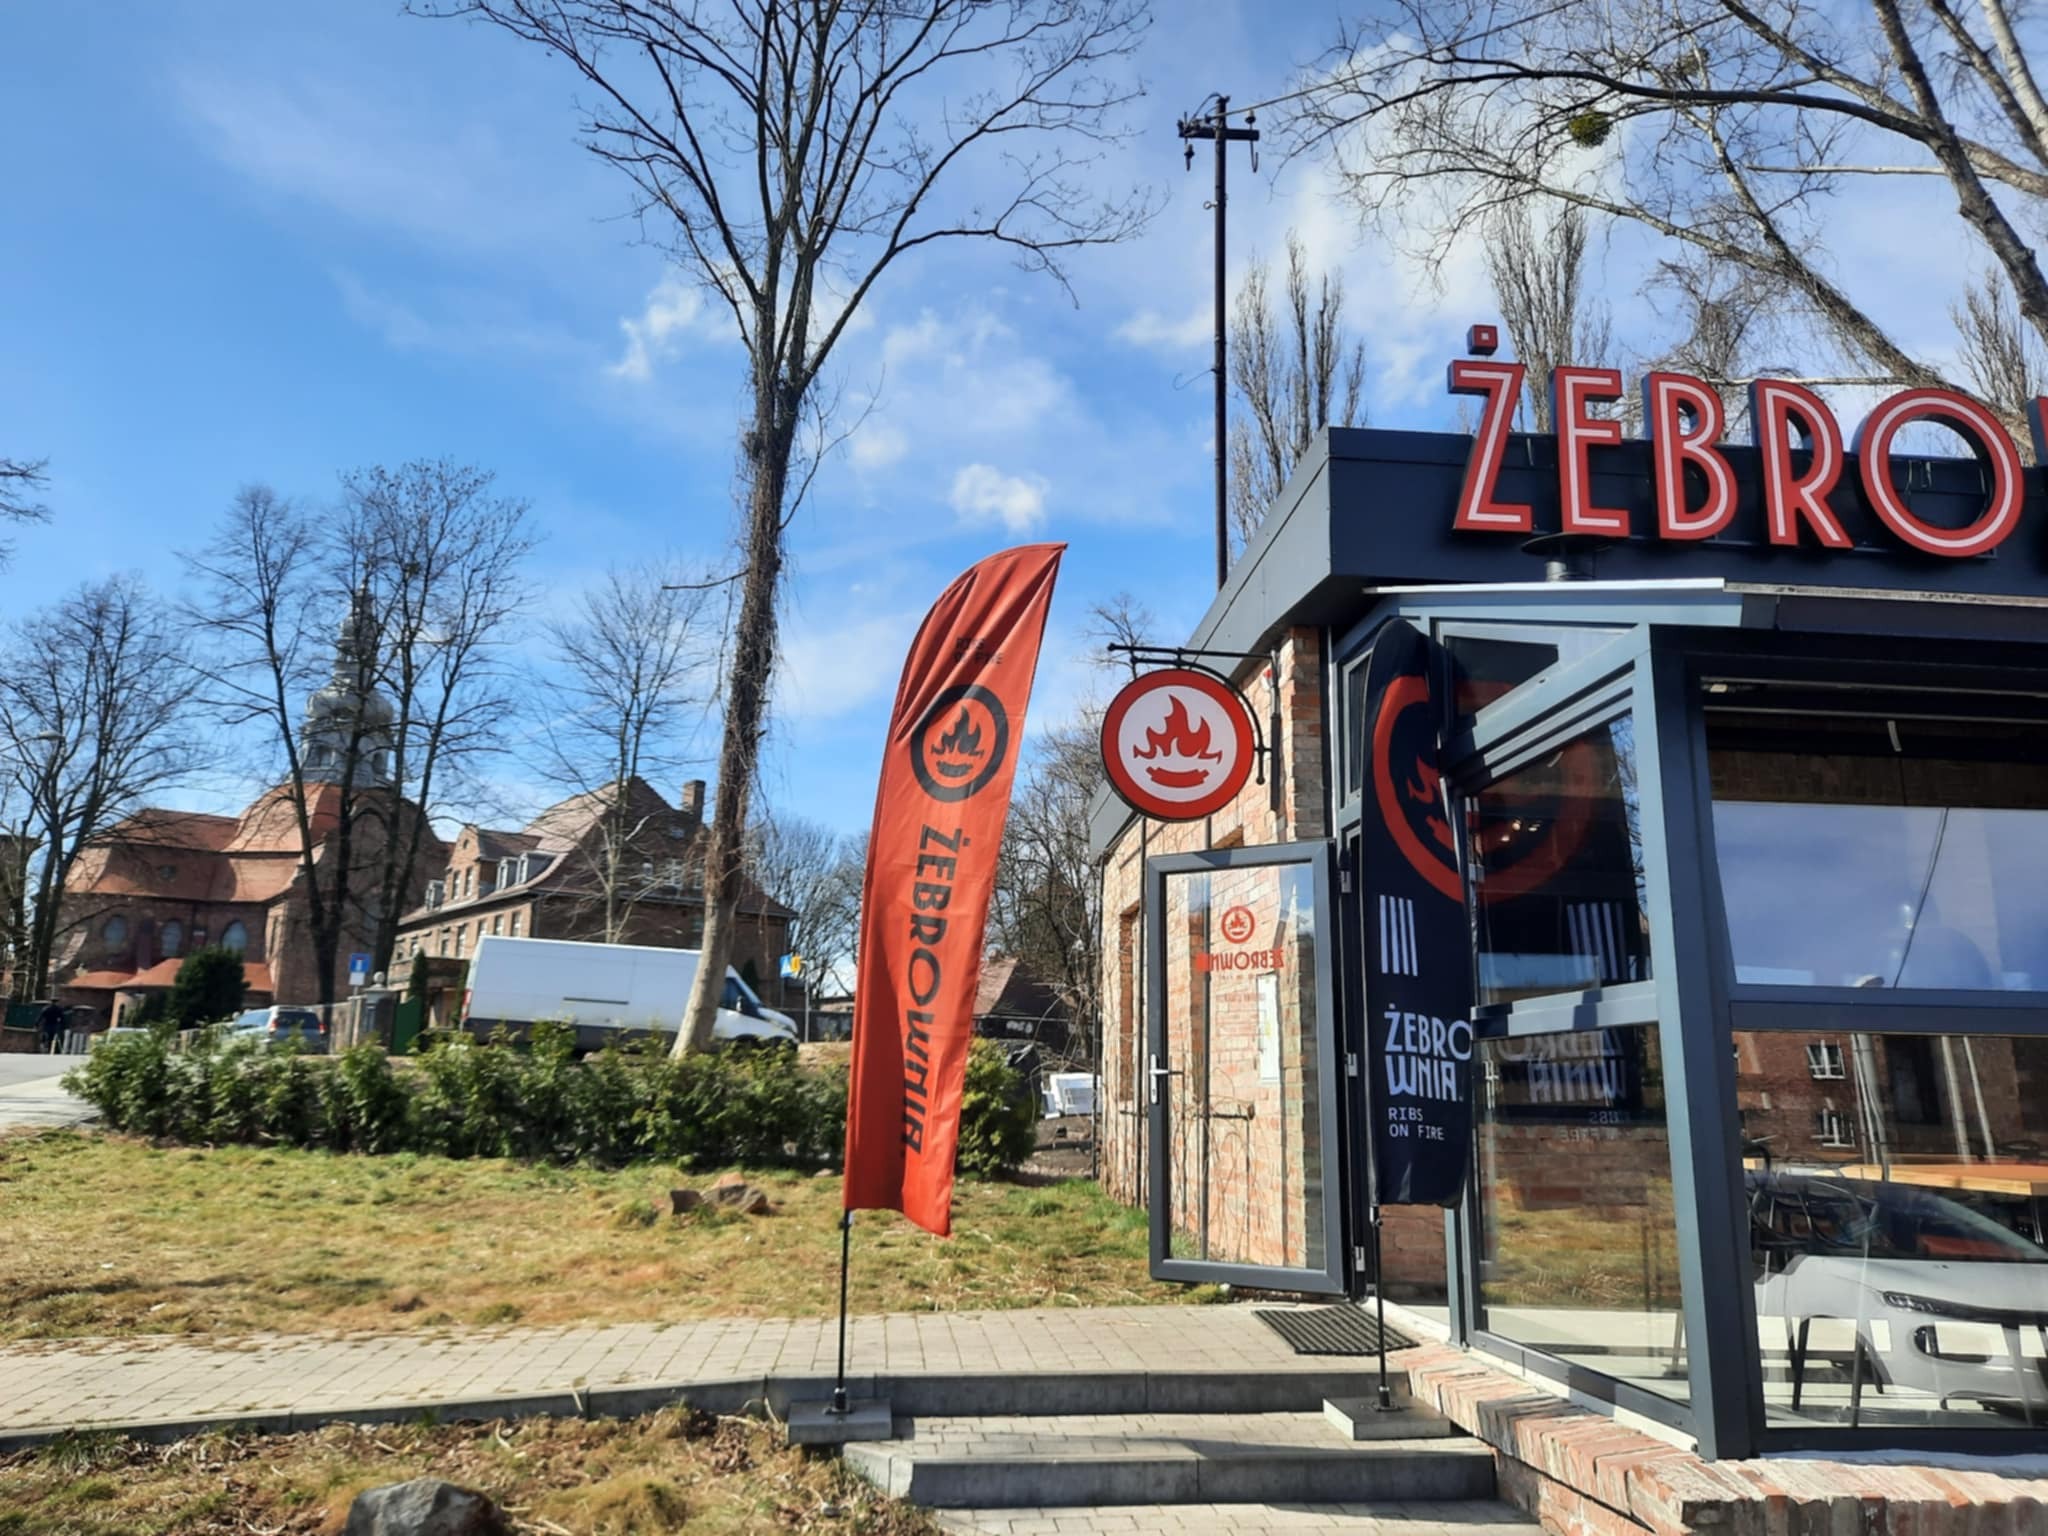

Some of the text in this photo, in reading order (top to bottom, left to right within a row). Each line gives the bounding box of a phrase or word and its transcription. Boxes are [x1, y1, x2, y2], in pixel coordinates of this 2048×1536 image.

[1447, 324, 2048, 558] ŻEBRO
[902, 823, 971, 1155] ŻEBROWNIA
[1383, 1002, 1473, 1061] ŻEBRO
[1387, 1106, 1424, 1122] RIBS
[1388, 1123, 1445, 1141] ON FIRE
